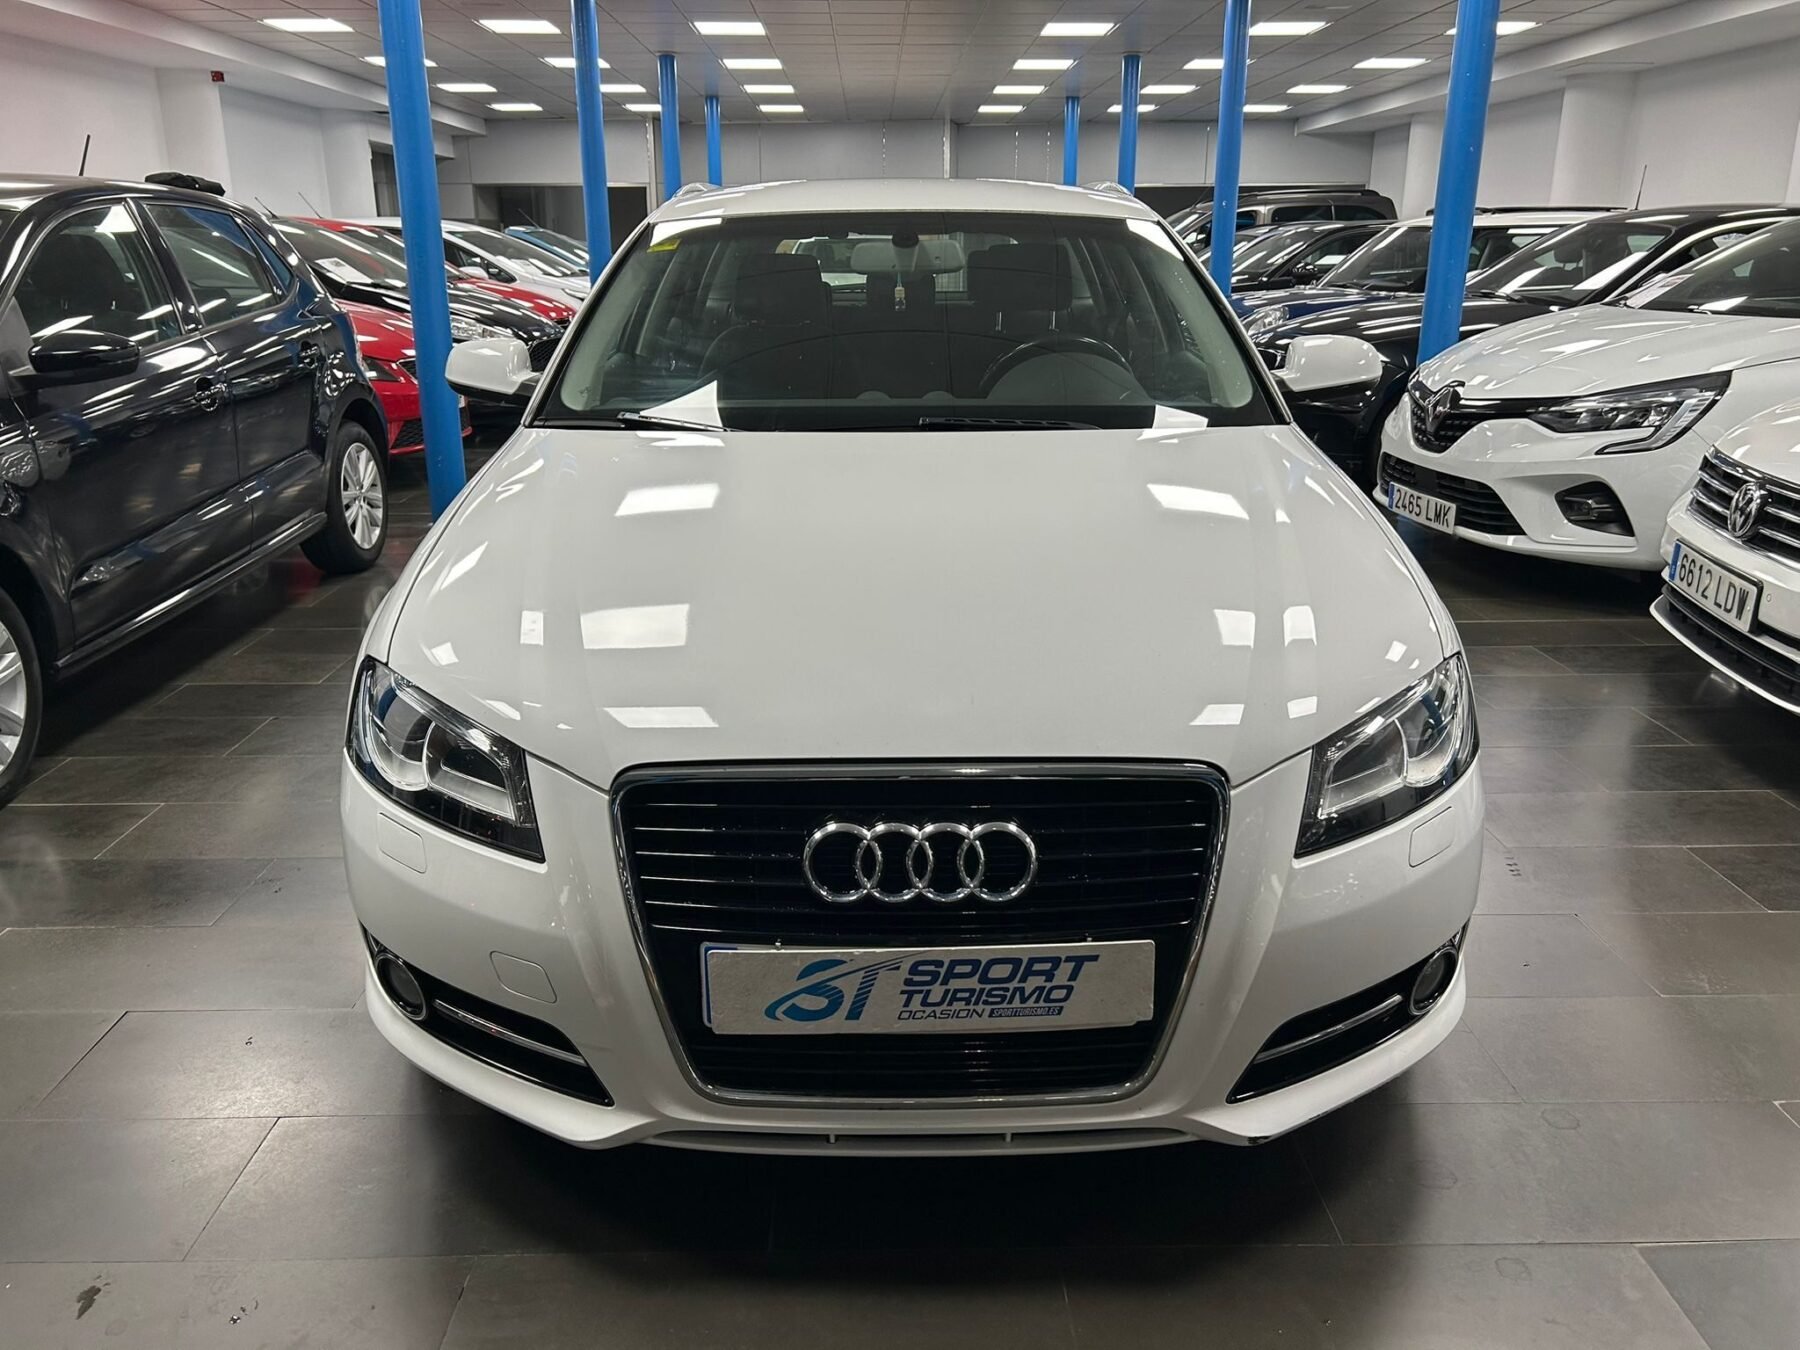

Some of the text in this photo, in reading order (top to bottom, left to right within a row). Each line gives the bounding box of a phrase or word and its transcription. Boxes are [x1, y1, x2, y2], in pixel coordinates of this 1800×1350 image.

[1395, 489, 1451, 528] 2465 LMK
[1679, 553, 1750, 621] 6612 LDW
[903, 954, 1100, 987] SPORT
[899, 984, 1075, 1008] TURISMO
[897, 1007, 986, 1020] OCASION
